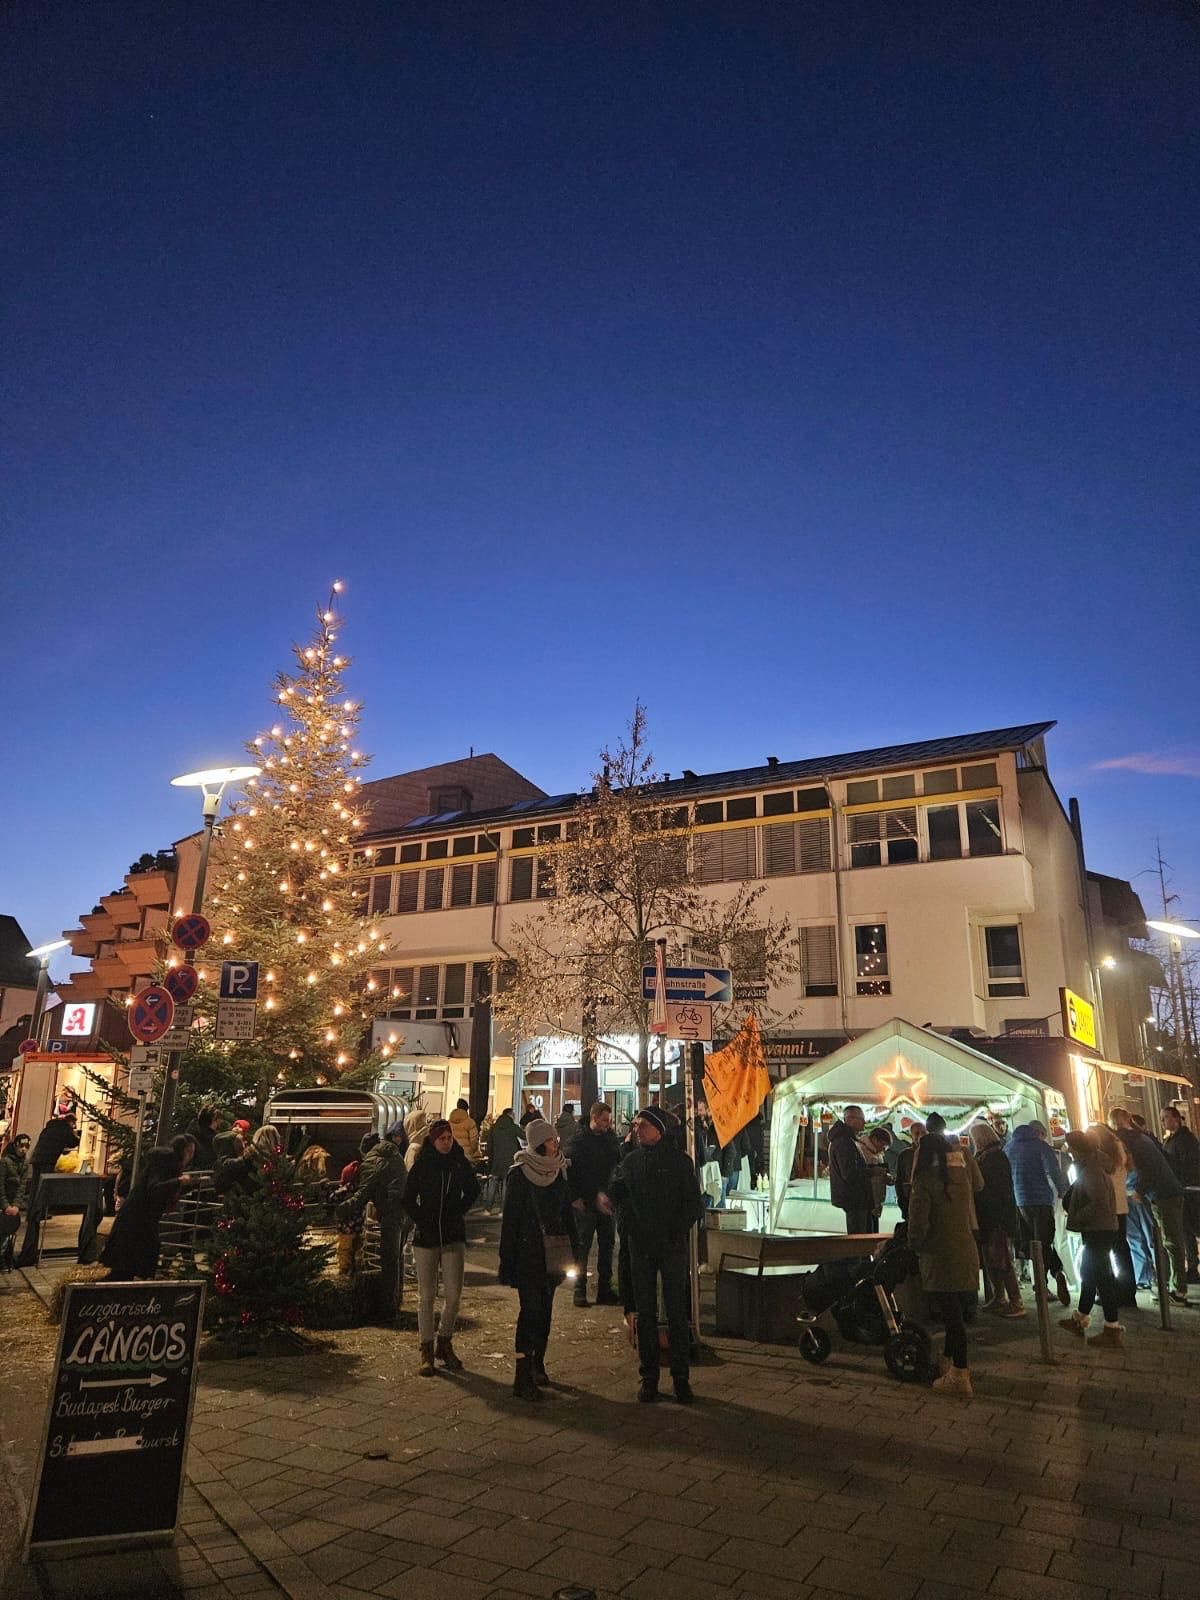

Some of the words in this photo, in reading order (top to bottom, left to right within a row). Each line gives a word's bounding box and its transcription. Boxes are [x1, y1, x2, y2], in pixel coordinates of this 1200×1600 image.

[229, 966, 250, 994] P
[808, 1041, 820, 1055] L.
[78, 1297, 161, 1323] ungarische
[55, 1391, 121, 1420] Budapest
[121, 1387, 175, 1420] Burger
